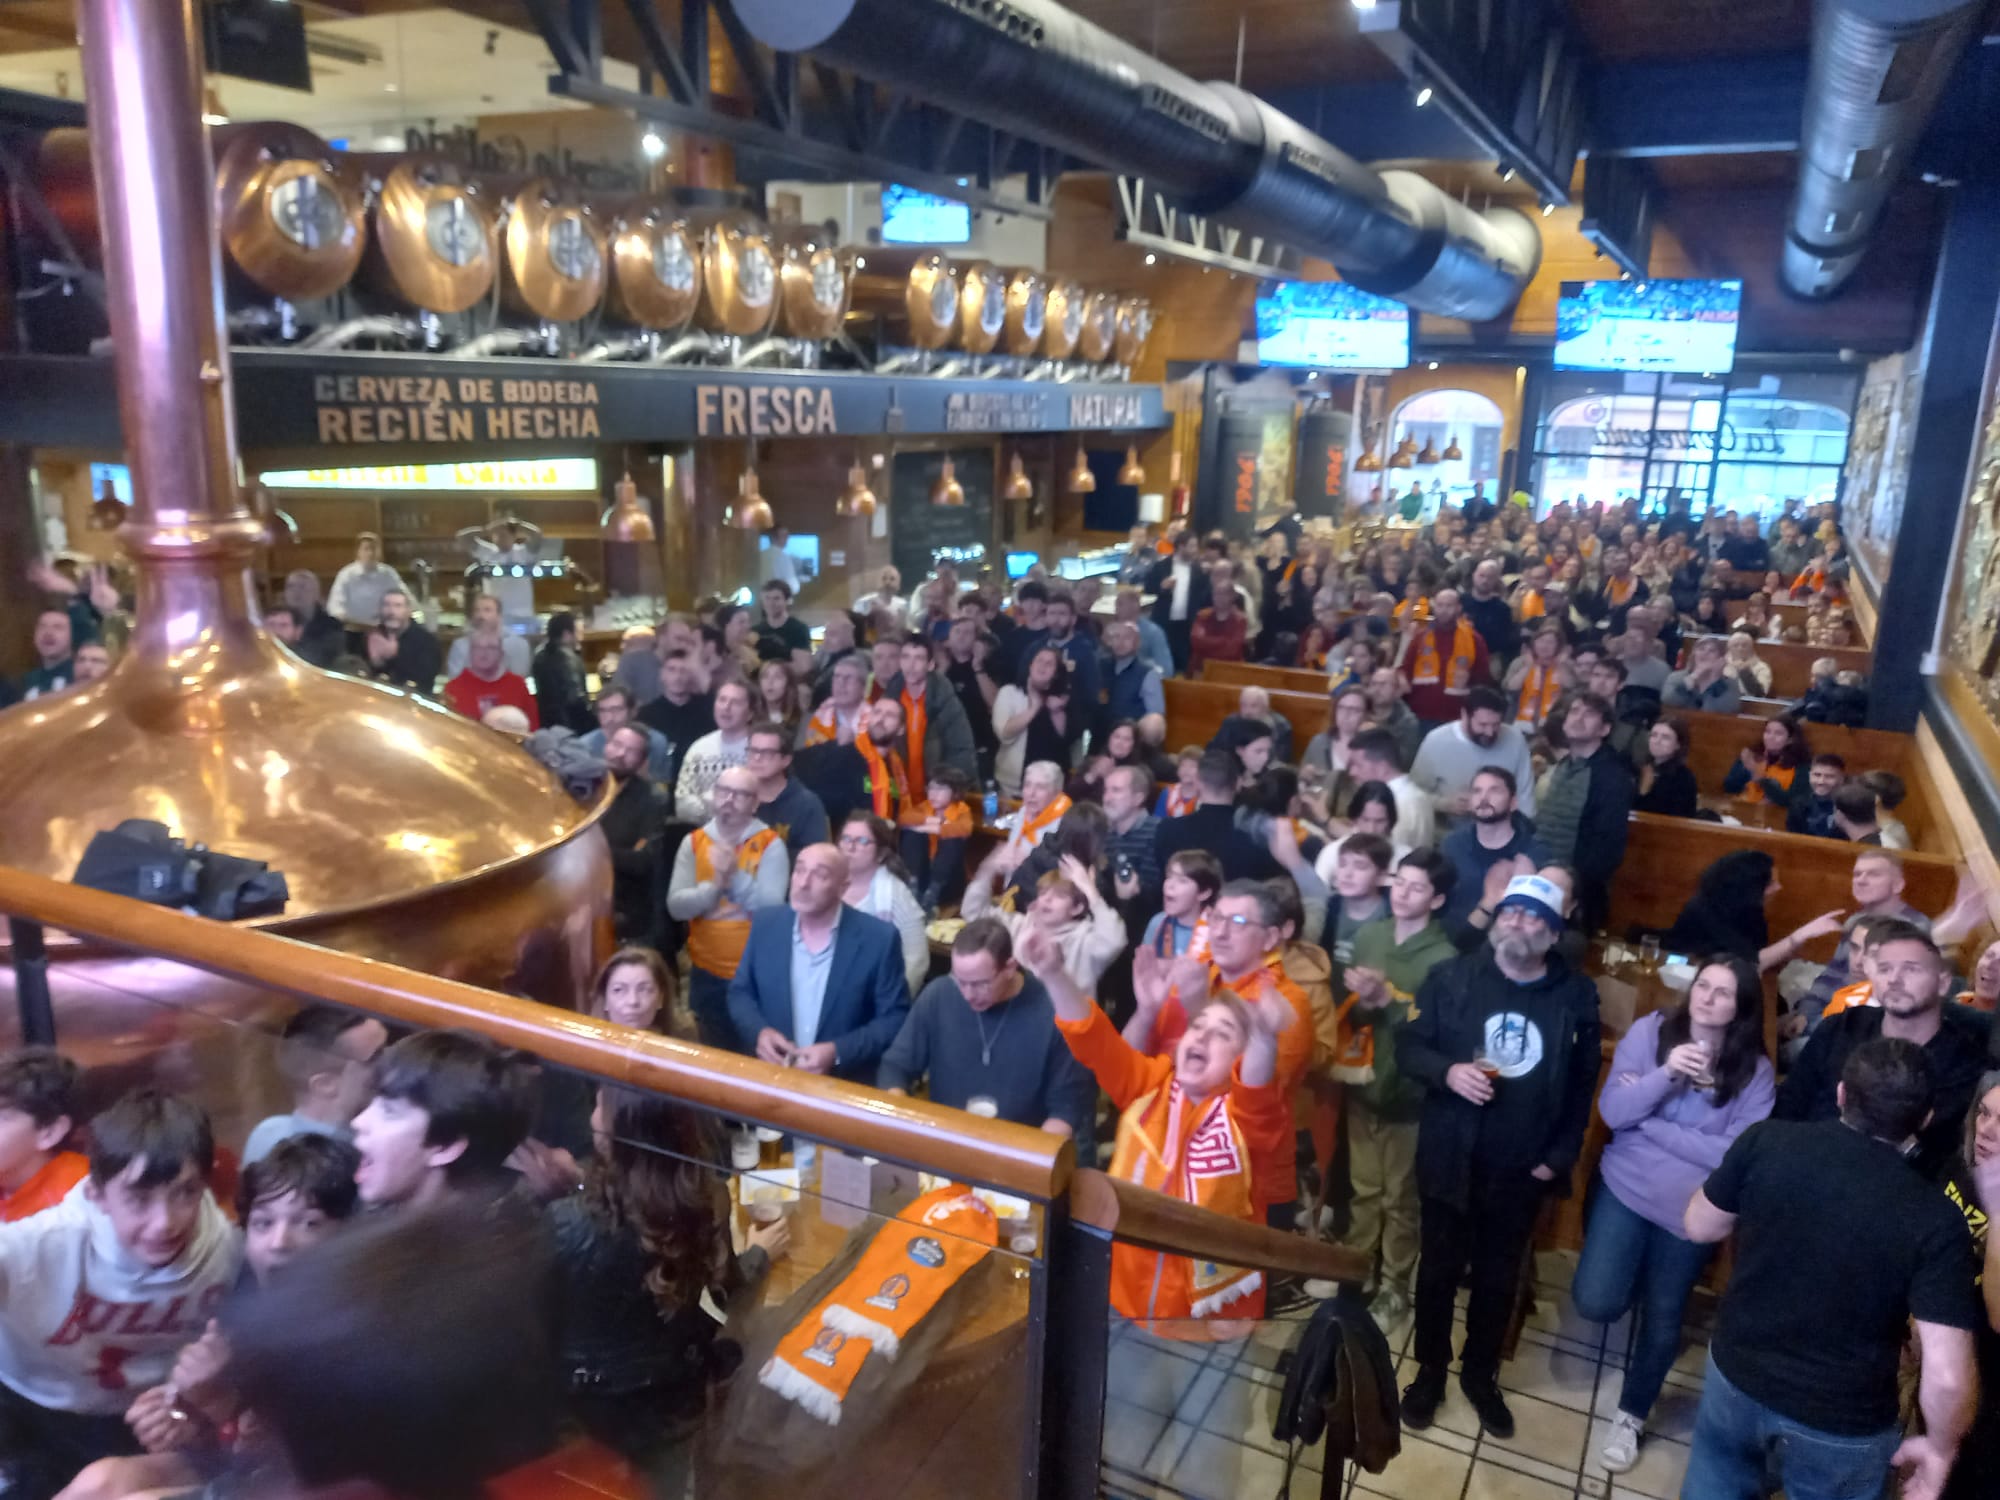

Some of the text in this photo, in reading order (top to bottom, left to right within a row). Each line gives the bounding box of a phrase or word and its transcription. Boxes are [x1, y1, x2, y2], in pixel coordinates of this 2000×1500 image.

[314, 375, 600, 404] CERVEZA DE BODEGA
[697, 385, 837, 436] FRESCA
[317, 400, 600, 443] RECIÉN HECHA
